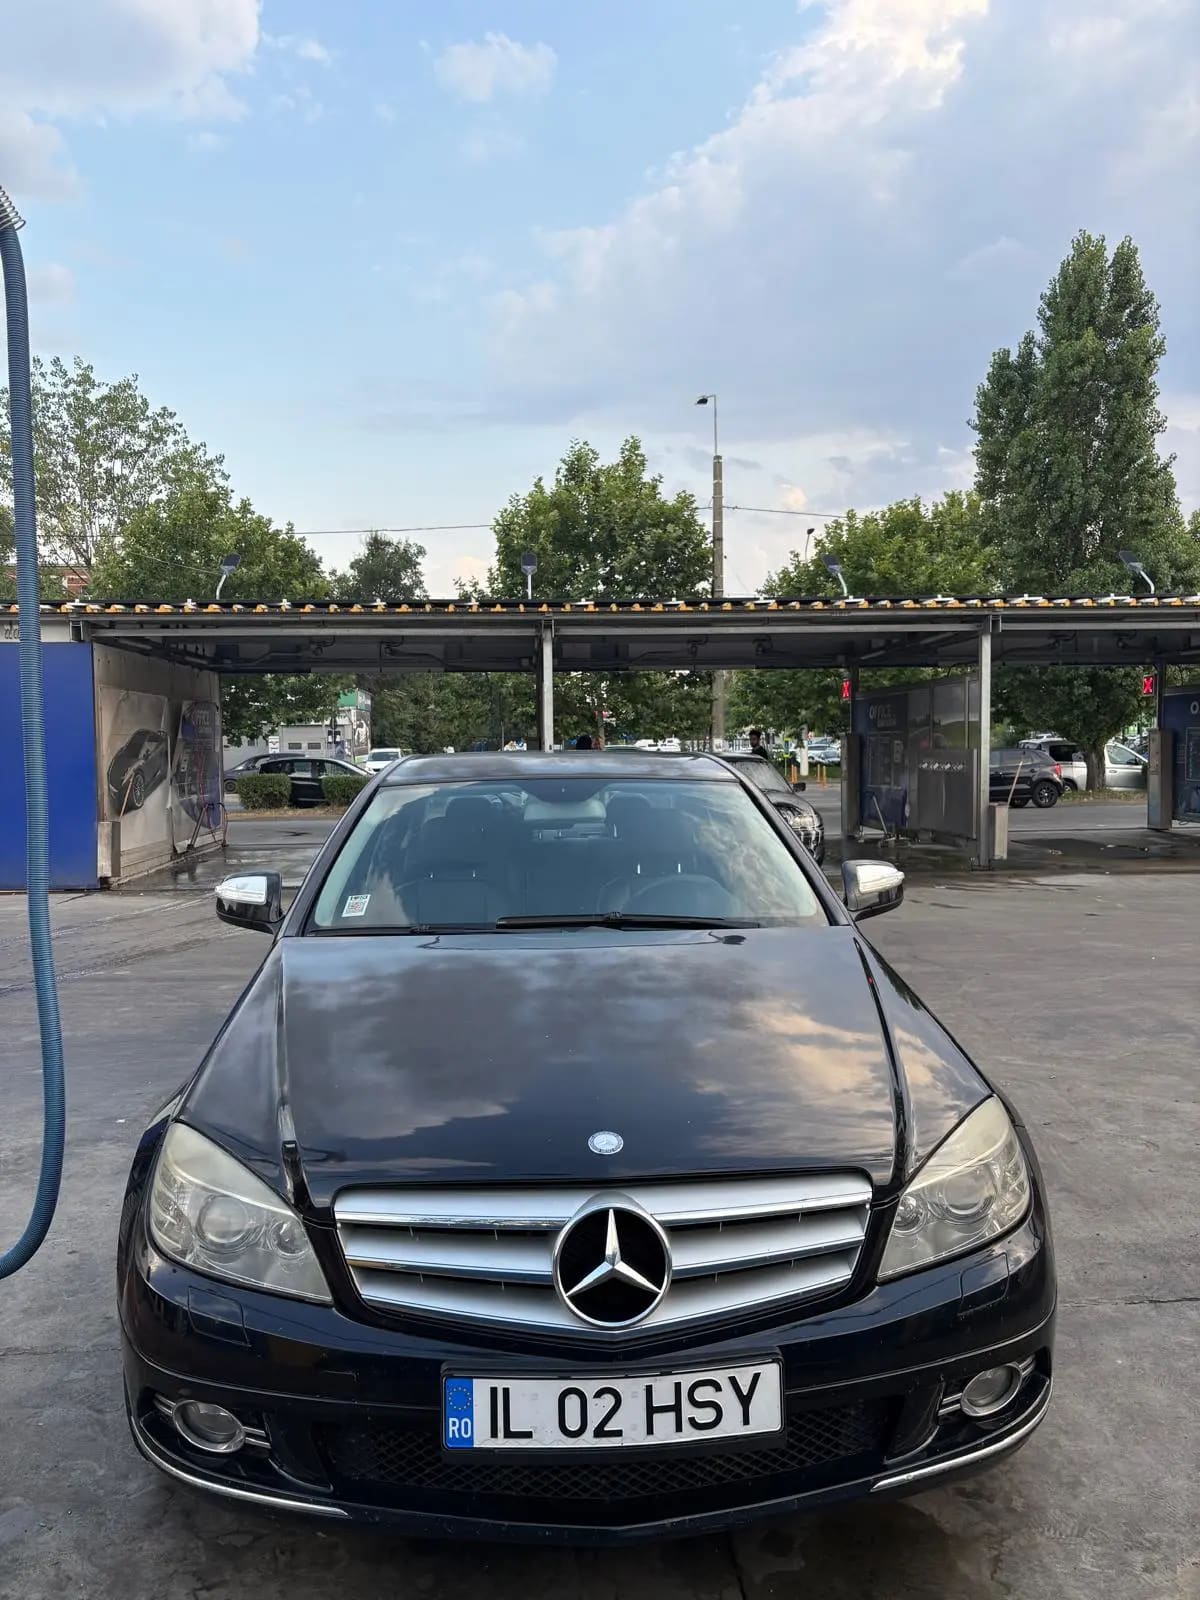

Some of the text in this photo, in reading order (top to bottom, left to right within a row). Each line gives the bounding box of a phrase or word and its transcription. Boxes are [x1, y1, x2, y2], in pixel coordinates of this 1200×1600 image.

[448, 1417, 472, 1438] RO
[489, 1372, 762, 1439] IL 02 HSY
